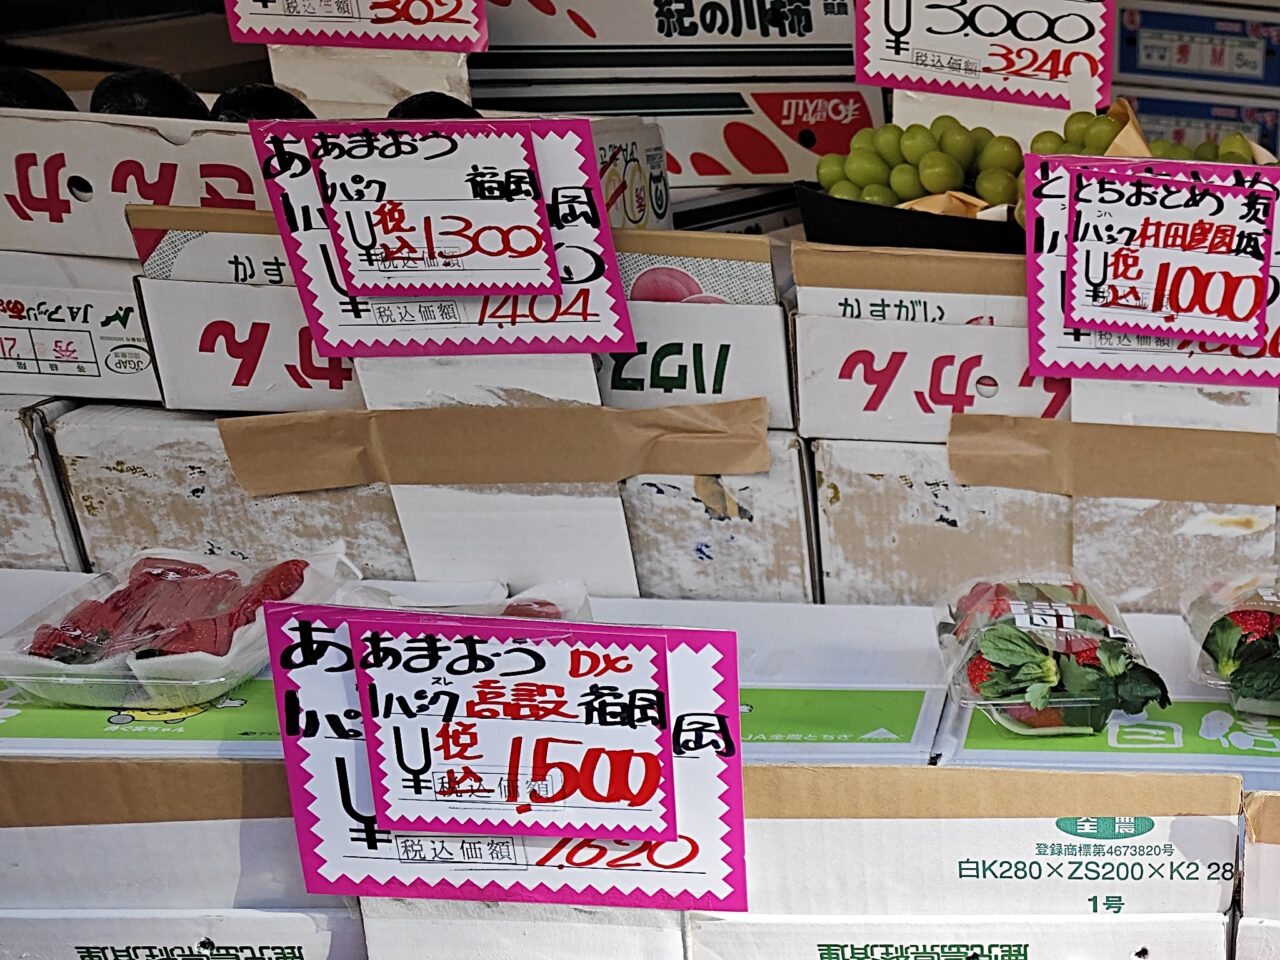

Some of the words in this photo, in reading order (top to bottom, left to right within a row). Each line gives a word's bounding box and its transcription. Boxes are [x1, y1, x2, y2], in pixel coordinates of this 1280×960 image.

[311, 128, 459, 161] あまおう
[464, 164, 542, 203] 福岡
[1073, 172, 1225, 216] とちおとめ
[376, 301, 459, 324] 税込価額
[358, 631, 548, 677] あまおう
[579, 684, 668, 730] 福岡
[399, 836, 514, 862] 税込価額
[1035, 842, 1175, 857] 登録商標第4673820号
[1087, 895, 1125, 914] 1号
